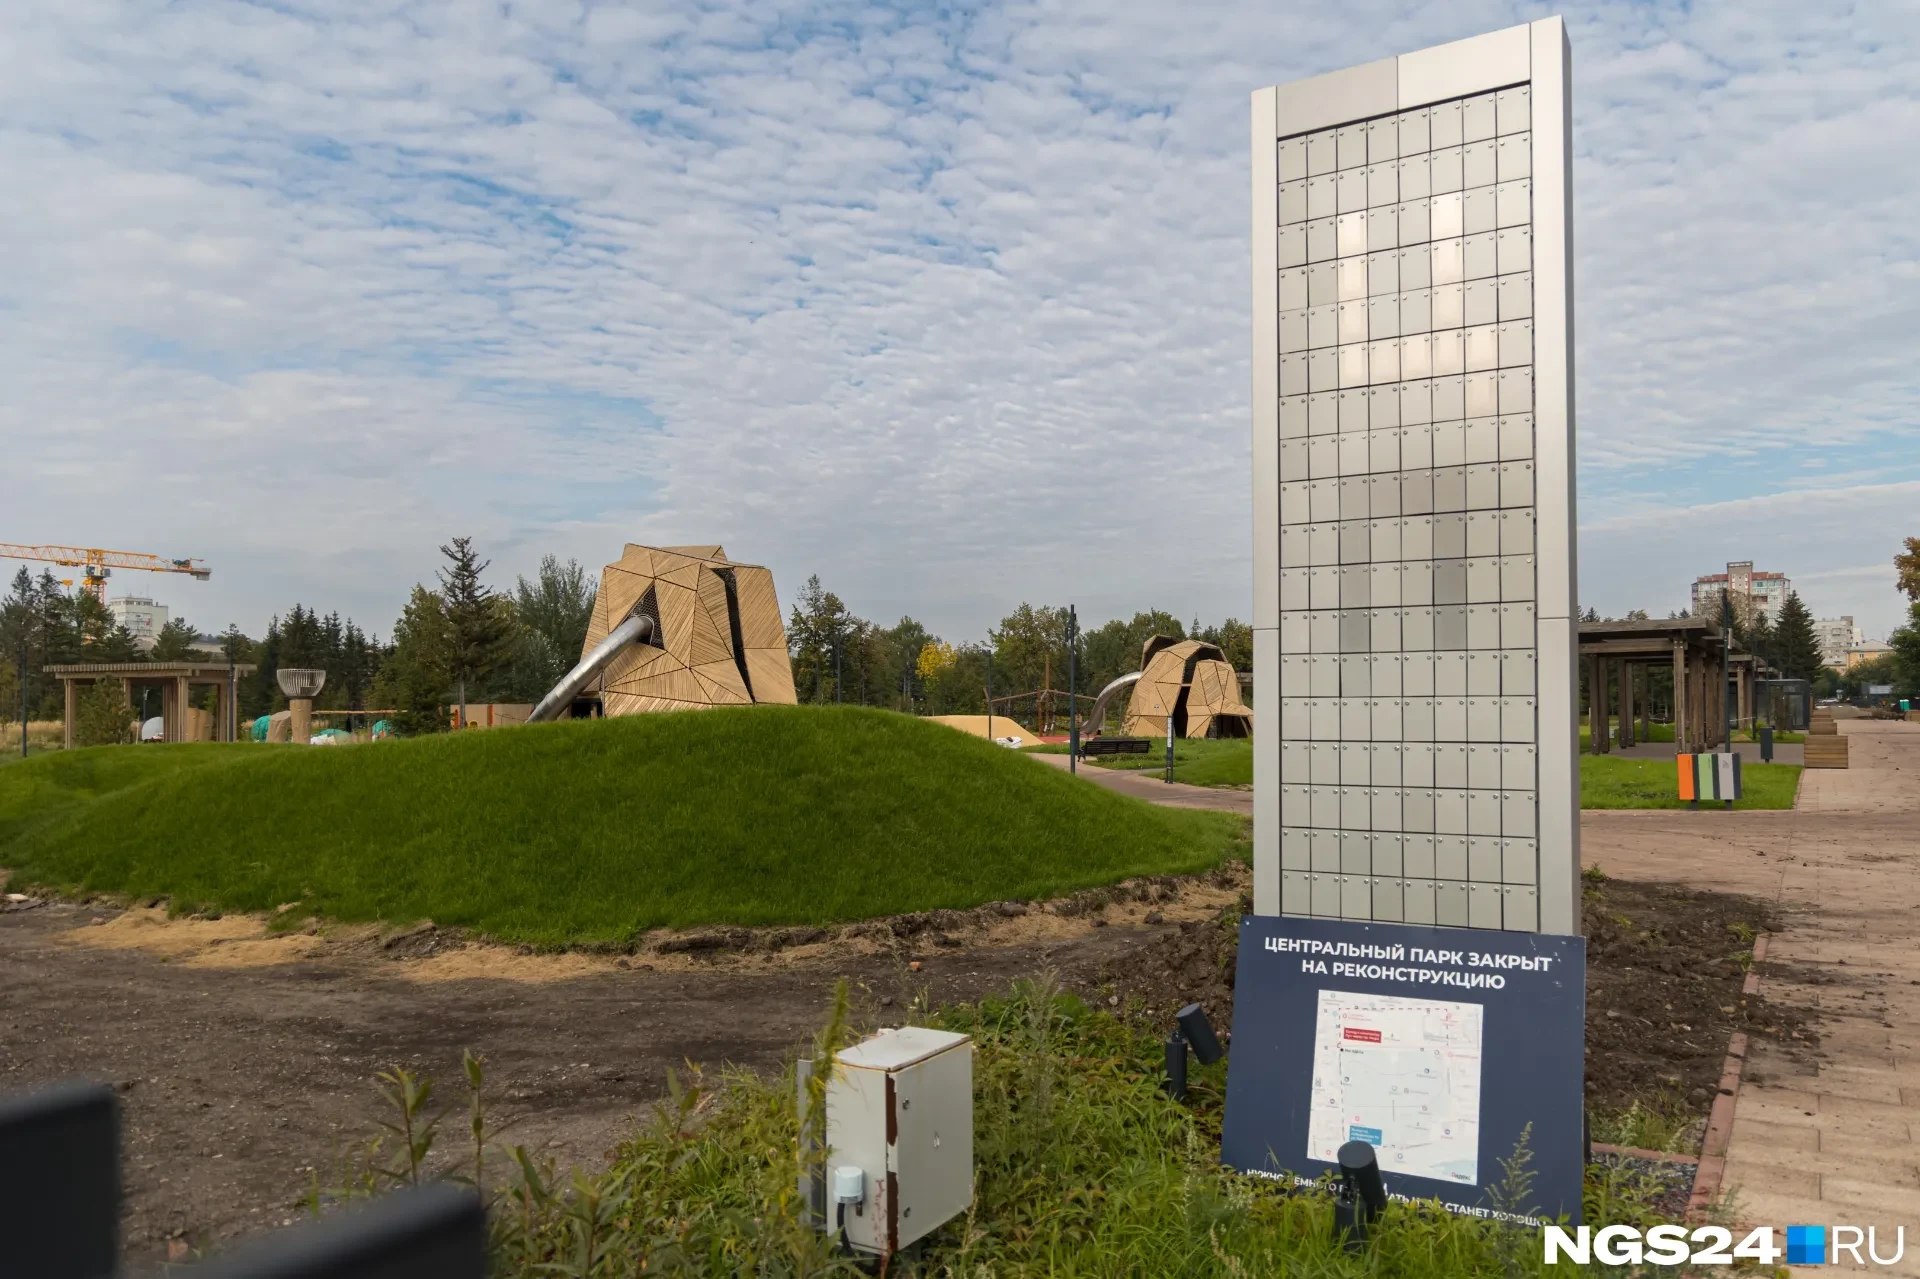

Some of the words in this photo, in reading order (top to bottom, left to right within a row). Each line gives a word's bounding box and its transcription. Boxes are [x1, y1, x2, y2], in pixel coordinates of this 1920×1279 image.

[1264, 937, 1405, 961] ЦЕНТРАЛЬНЫЙ
[1410, 947, 1464, 966] ПАРК
[1467, 951, 1553, 972] ЗАКРЫТ
[1301, 959, 1329, 975] НА
[1332, 961, 1506, 990] РЕКОНСТРУКЦИЮ
[1444, 1202, 1490, 1218] СТАНЕТ
